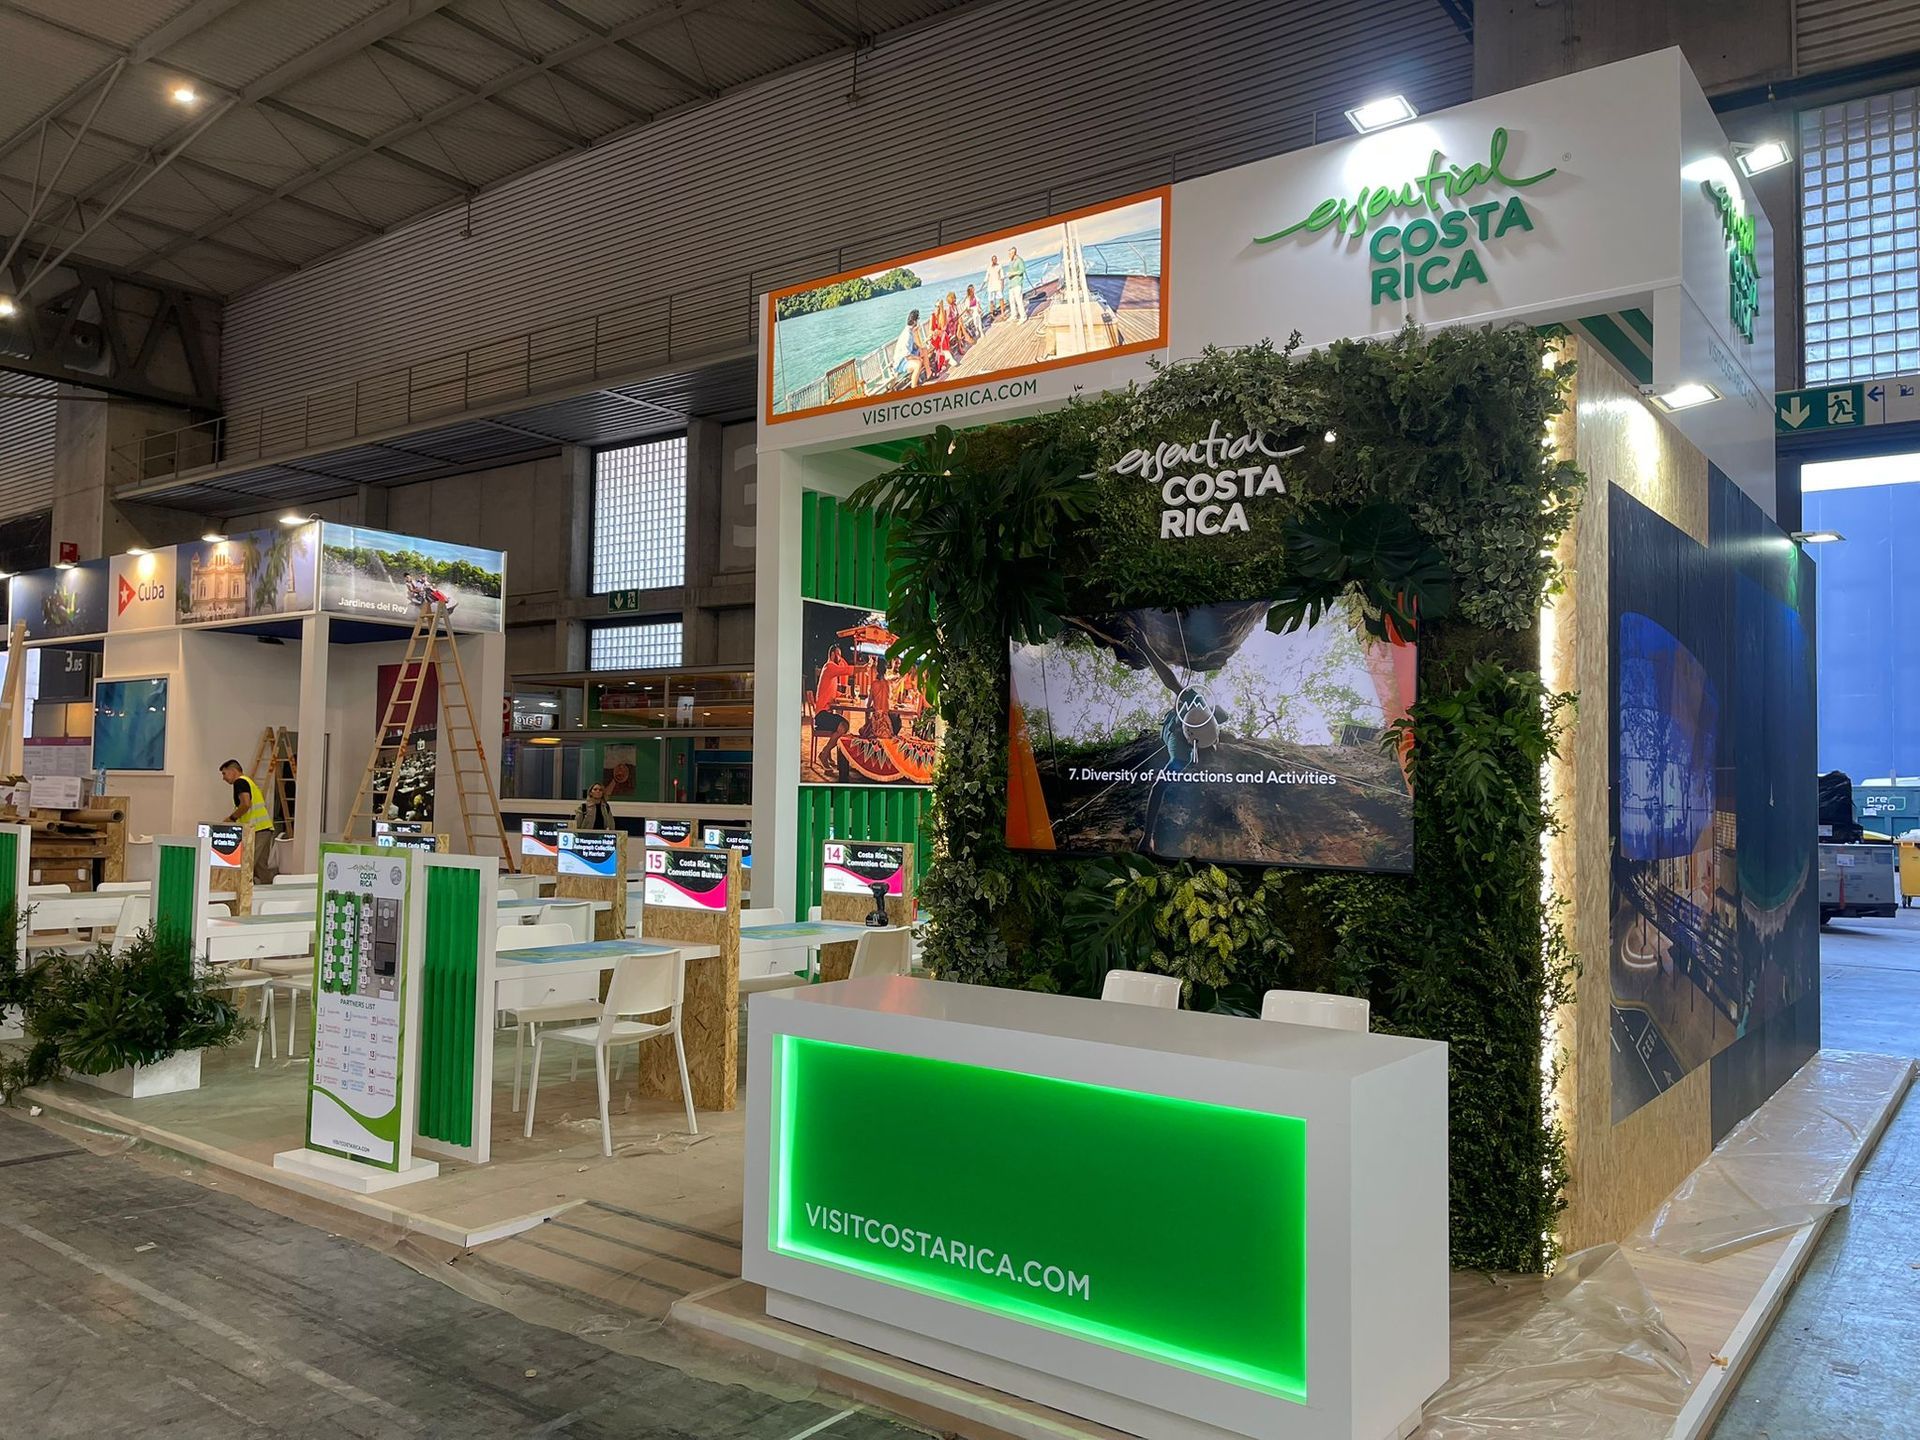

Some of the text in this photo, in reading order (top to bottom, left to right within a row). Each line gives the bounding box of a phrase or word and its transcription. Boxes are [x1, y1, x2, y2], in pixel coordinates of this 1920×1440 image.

[1253, 127, 1557, 243] essential
[1370, 196, 1534, 263] COSTA
[1371, 249, 1488, 305] RICA
[862, 379, 1037, 426] VISITCOSTARICA.COM
[1078, 418, 1306, 483] essential
[1161, 464, 1287, 507] COSTA
[1160, 502, 1250, 539] RICA
[138, 579, 165, 602] Cuba
[338, 597, 409, 614] Jardines del Rey
[65, 650, 82, 672] 3.05
[1068, 768, 1337, 785] 7. Diversity of Attractions and Activities
[1867, 796, 1888, 805] pre
[562, 835, 569, 846] 9
[709, 831, 714, 841] 8
[649, 854, 662, 869] 15
[827, 847, 841, 860] 14
[679, 859, 696, 867] Costa
[360, 872, 377, 880] COSTA
[667, 869, 722, 879] Convention Bureau
[340, 999, 364, 1009] PARTNERS
[805, 1202, 1091, 1301] VISITCOSTARICA.COM
